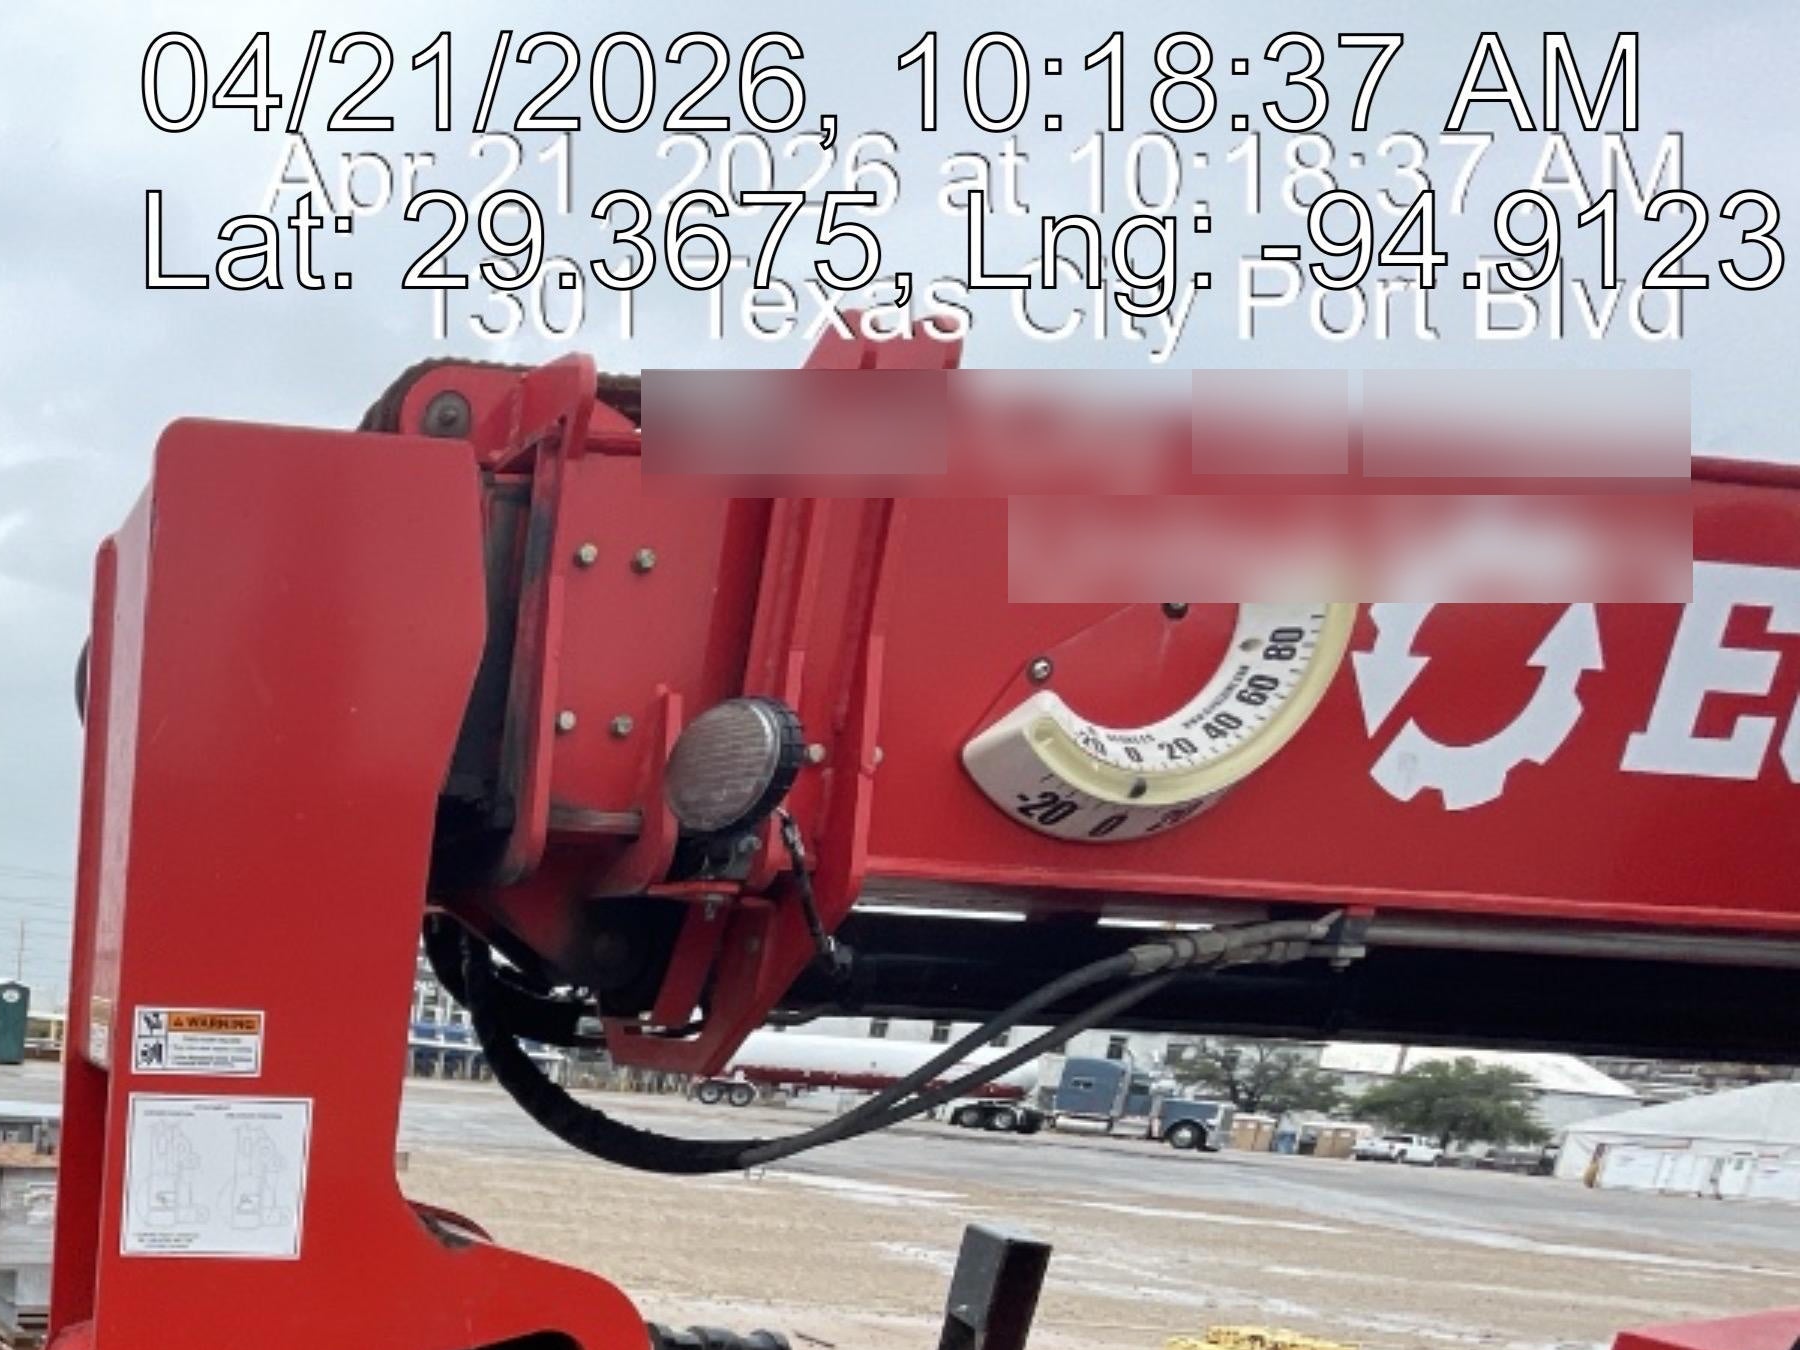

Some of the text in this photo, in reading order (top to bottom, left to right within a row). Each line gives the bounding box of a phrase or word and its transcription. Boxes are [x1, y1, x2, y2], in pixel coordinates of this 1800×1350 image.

[1263, 625, 1305, 661] 80
[1619, 560, 1800, 783] E
[1235, 673, 1279, 706] 60
[1202, 712, 1243, 745] 40
[1157, 736, 1198, 760] 20
[1016, 791, 1078, 825] -20
